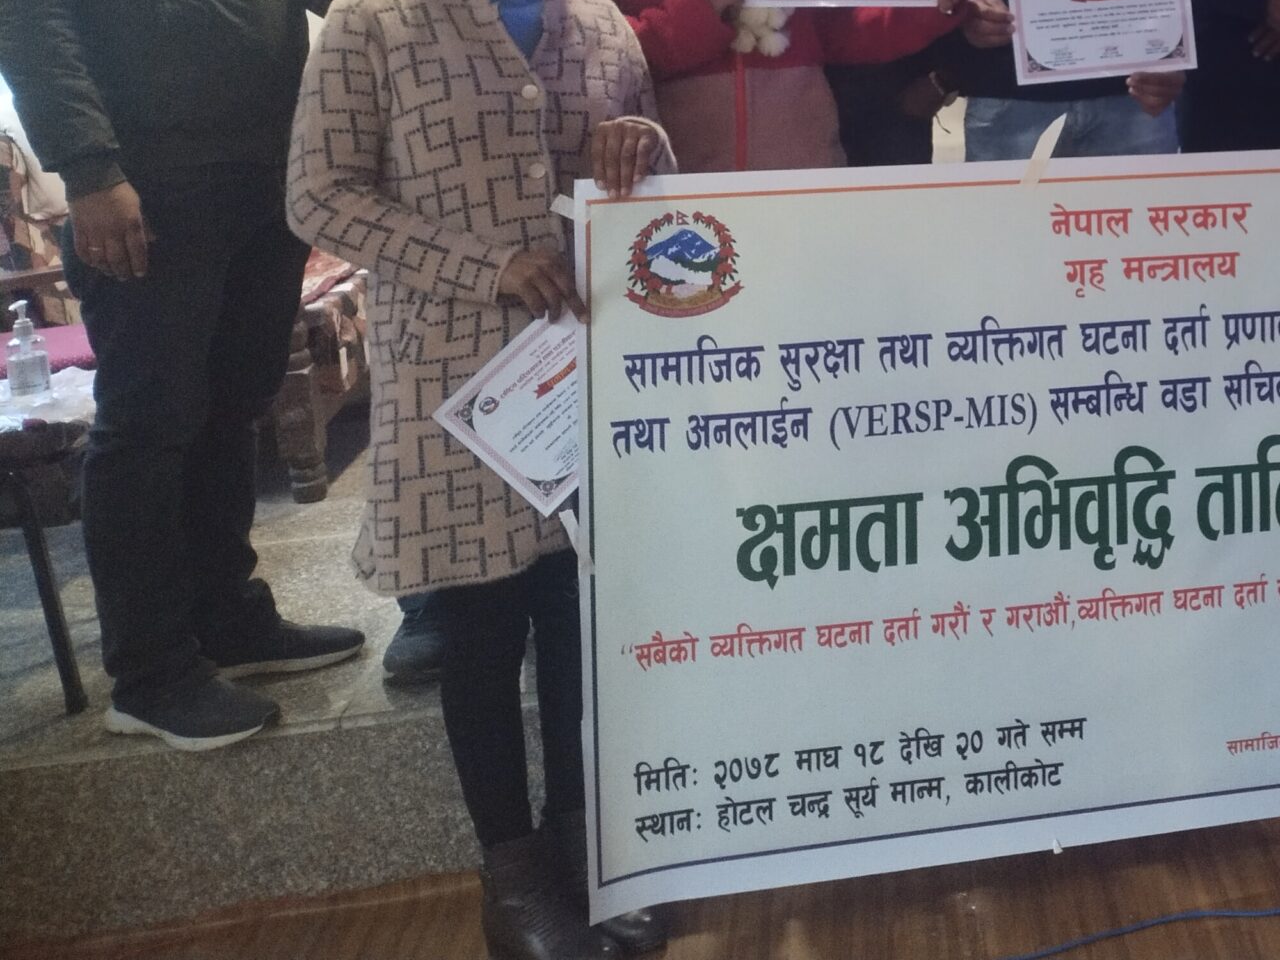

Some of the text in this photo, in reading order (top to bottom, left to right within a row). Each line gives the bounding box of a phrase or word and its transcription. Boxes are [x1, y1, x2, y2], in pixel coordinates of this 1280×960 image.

[1050, 203, 1252, 237] नेपाल सरकार
[1064, 252, 1240, 298] गृह मन्त्रालय
[623, 335, 765, 393] सामाजिक
[778, 338, 865, 391] सुरक्षा
[877, 334, 933, 373] तथा
[945, 316, 1067, 365] व्यक्तिगत
[1079, 319, 1151, 355] घटना
[1162, 304, 1211, 355] दर्ता
[610, 417, 671, 458] तथा
[686, 396, 813, 451] अनलाईन
[830, 393, 1037, 450] (VERSP-MIS)
[1048, 370, 1148, 425] सम्बन्धि
[1159, 376, 1211, 413] वडा
[736, 492, 924, 590] क्षमता
[709, 623, 806, 658] व्यक्तिगत
[816, 621, 873, 648] घटना
[883, 608, 921, 646] दर्ता
[979, 609, 996, 636] र
[1173, 585, 1225, 611] घटना
[1233, 573, 1268, 609] दर्ता
[714, 753, 780, 790] २०७८
[794, 746, 843, 772] माघ
[854, 741, 885, 767] १८
[898, 727, 945, 765] देखि
[956, 730, 983, 760] २०
[996, 719, 1030, 749] गते
[1040, 718, 1087, 747] सम्म
[716, 796, 776, 832] होटल
[787, 791, 832, 818] चन्द्र
[842, 776, 880, 818] सूर्य
[964, 758, 1064, 795] कालीकोट
